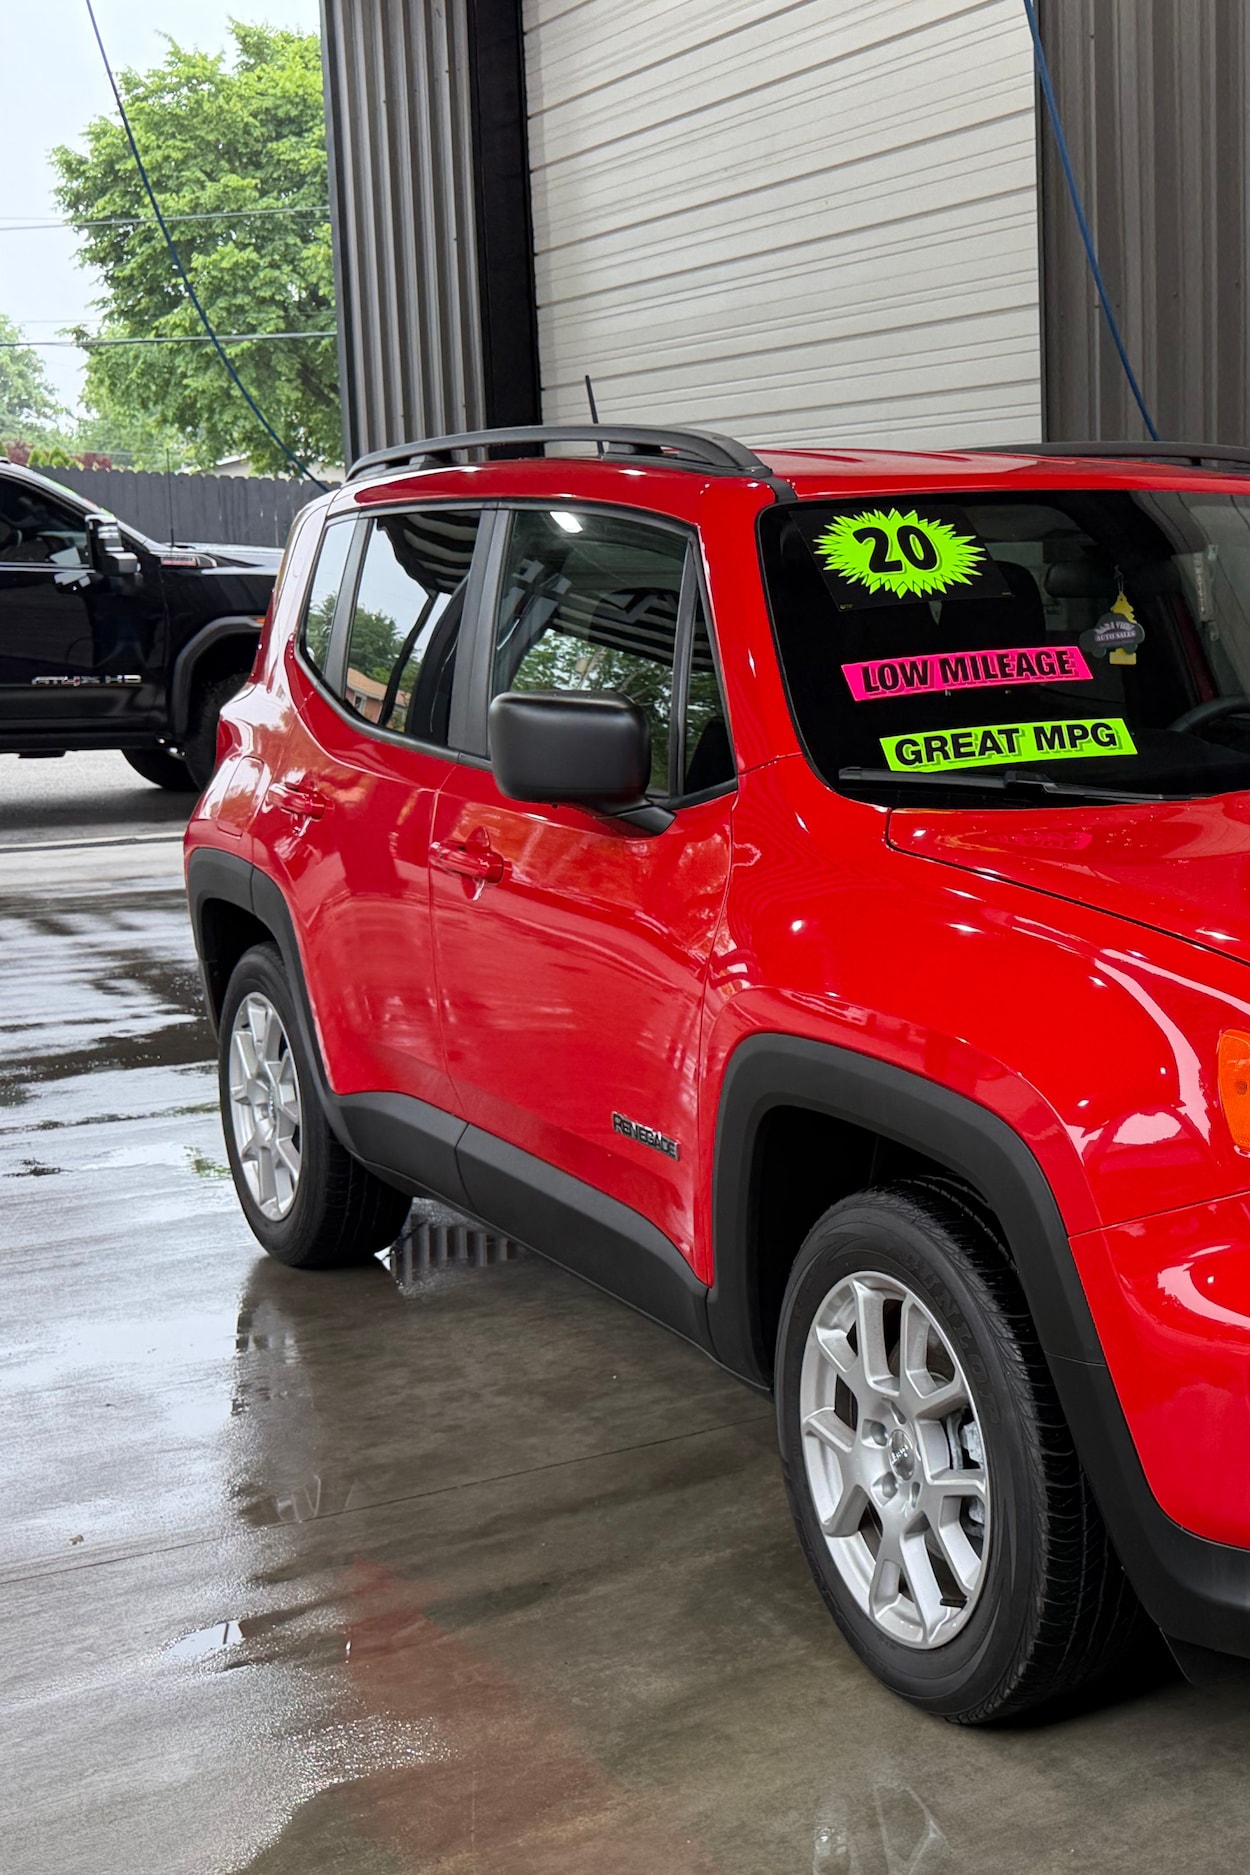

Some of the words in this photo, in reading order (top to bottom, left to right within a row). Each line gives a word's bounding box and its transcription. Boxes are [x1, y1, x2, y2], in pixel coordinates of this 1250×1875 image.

[852, 525, 938, 573] 20
[1096, 633, 1115, 642] AUTO
[861, 660, 929, 693] LOW
[939, 650, 1074, 684] MILEAGE
[895, 728, 1020, 766] GREAT
[1033, 722, 1118, 751] MPG
[612, 1111, 680, 1161] RENEGADE
